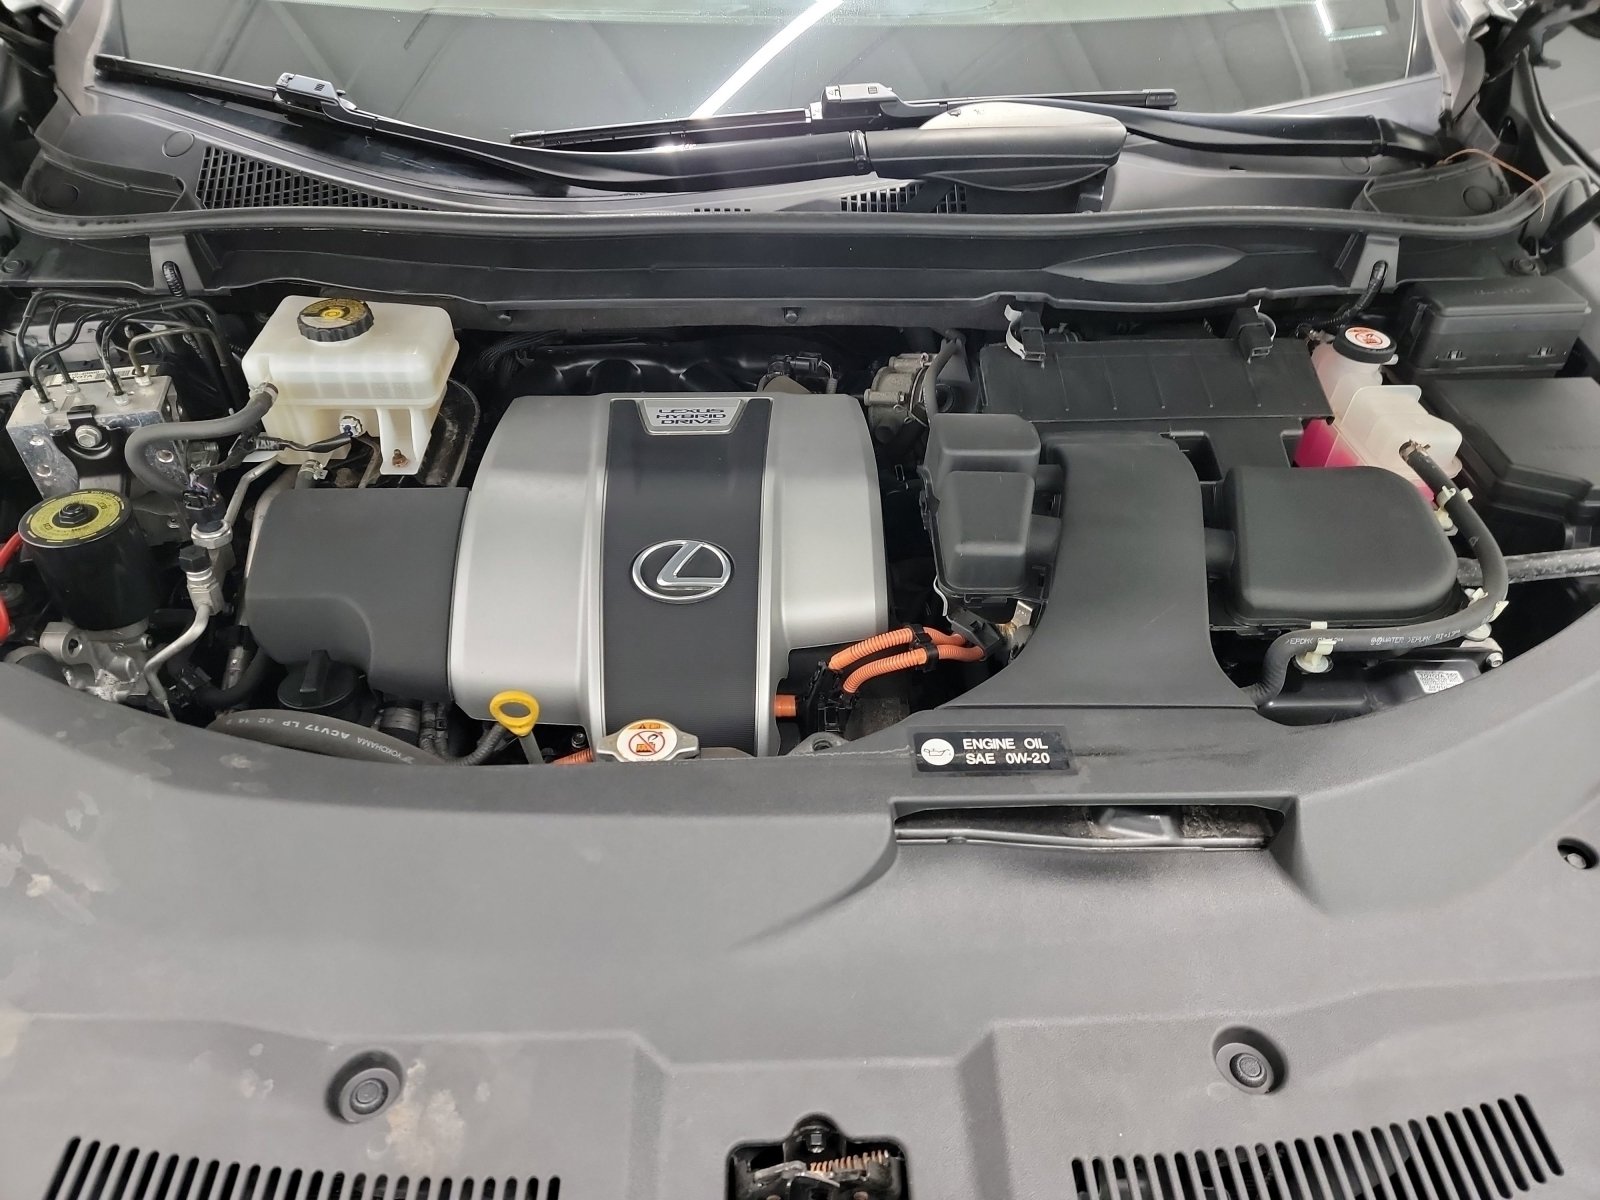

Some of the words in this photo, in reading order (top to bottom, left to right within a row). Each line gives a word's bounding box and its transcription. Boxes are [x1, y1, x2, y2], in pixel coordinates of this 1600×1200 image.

[282, 720, 299, 728] LP
[304, 724, 351, 740] ACV17
[357, 736, 402, 759] YOKOHAMA
[962, 738, 1016, 750] ENGINE
[1023, 738, 1049, 749] OIL
[965, 753, 996, 765] SAE
[1005, 752, 1050, 764] 0W-20
